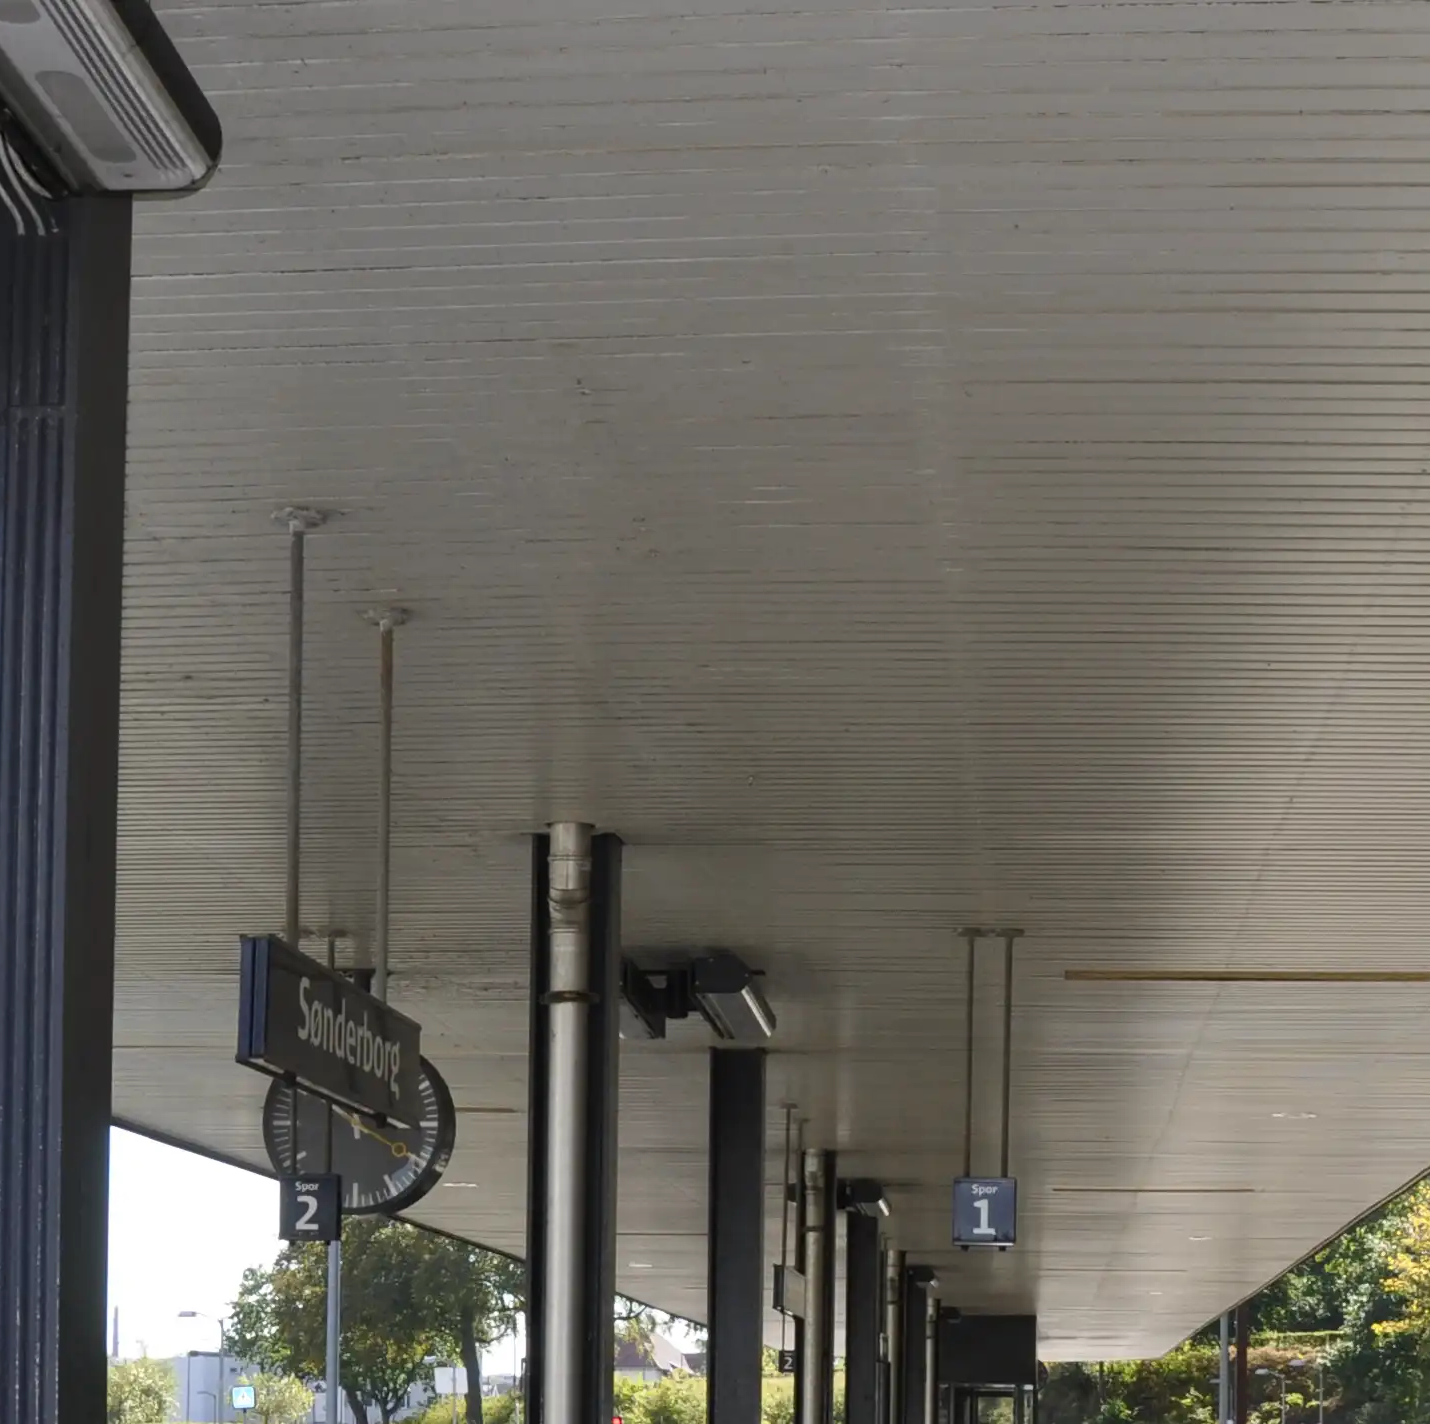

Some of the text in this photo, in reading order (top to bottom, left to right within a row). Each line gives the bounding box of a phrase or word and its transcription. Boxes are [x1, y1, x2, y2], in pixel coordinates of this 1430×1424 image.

[297, 976, 400, 1100] Sønderborg
[295, 1181, 320, 1192] Spor
[971, 1184, 999, 1197] Spor
[295, 1195, 319, 1230] 2
[972, 1198, 996, 1235] 1
[783, 1356, 793, 1369] 2
